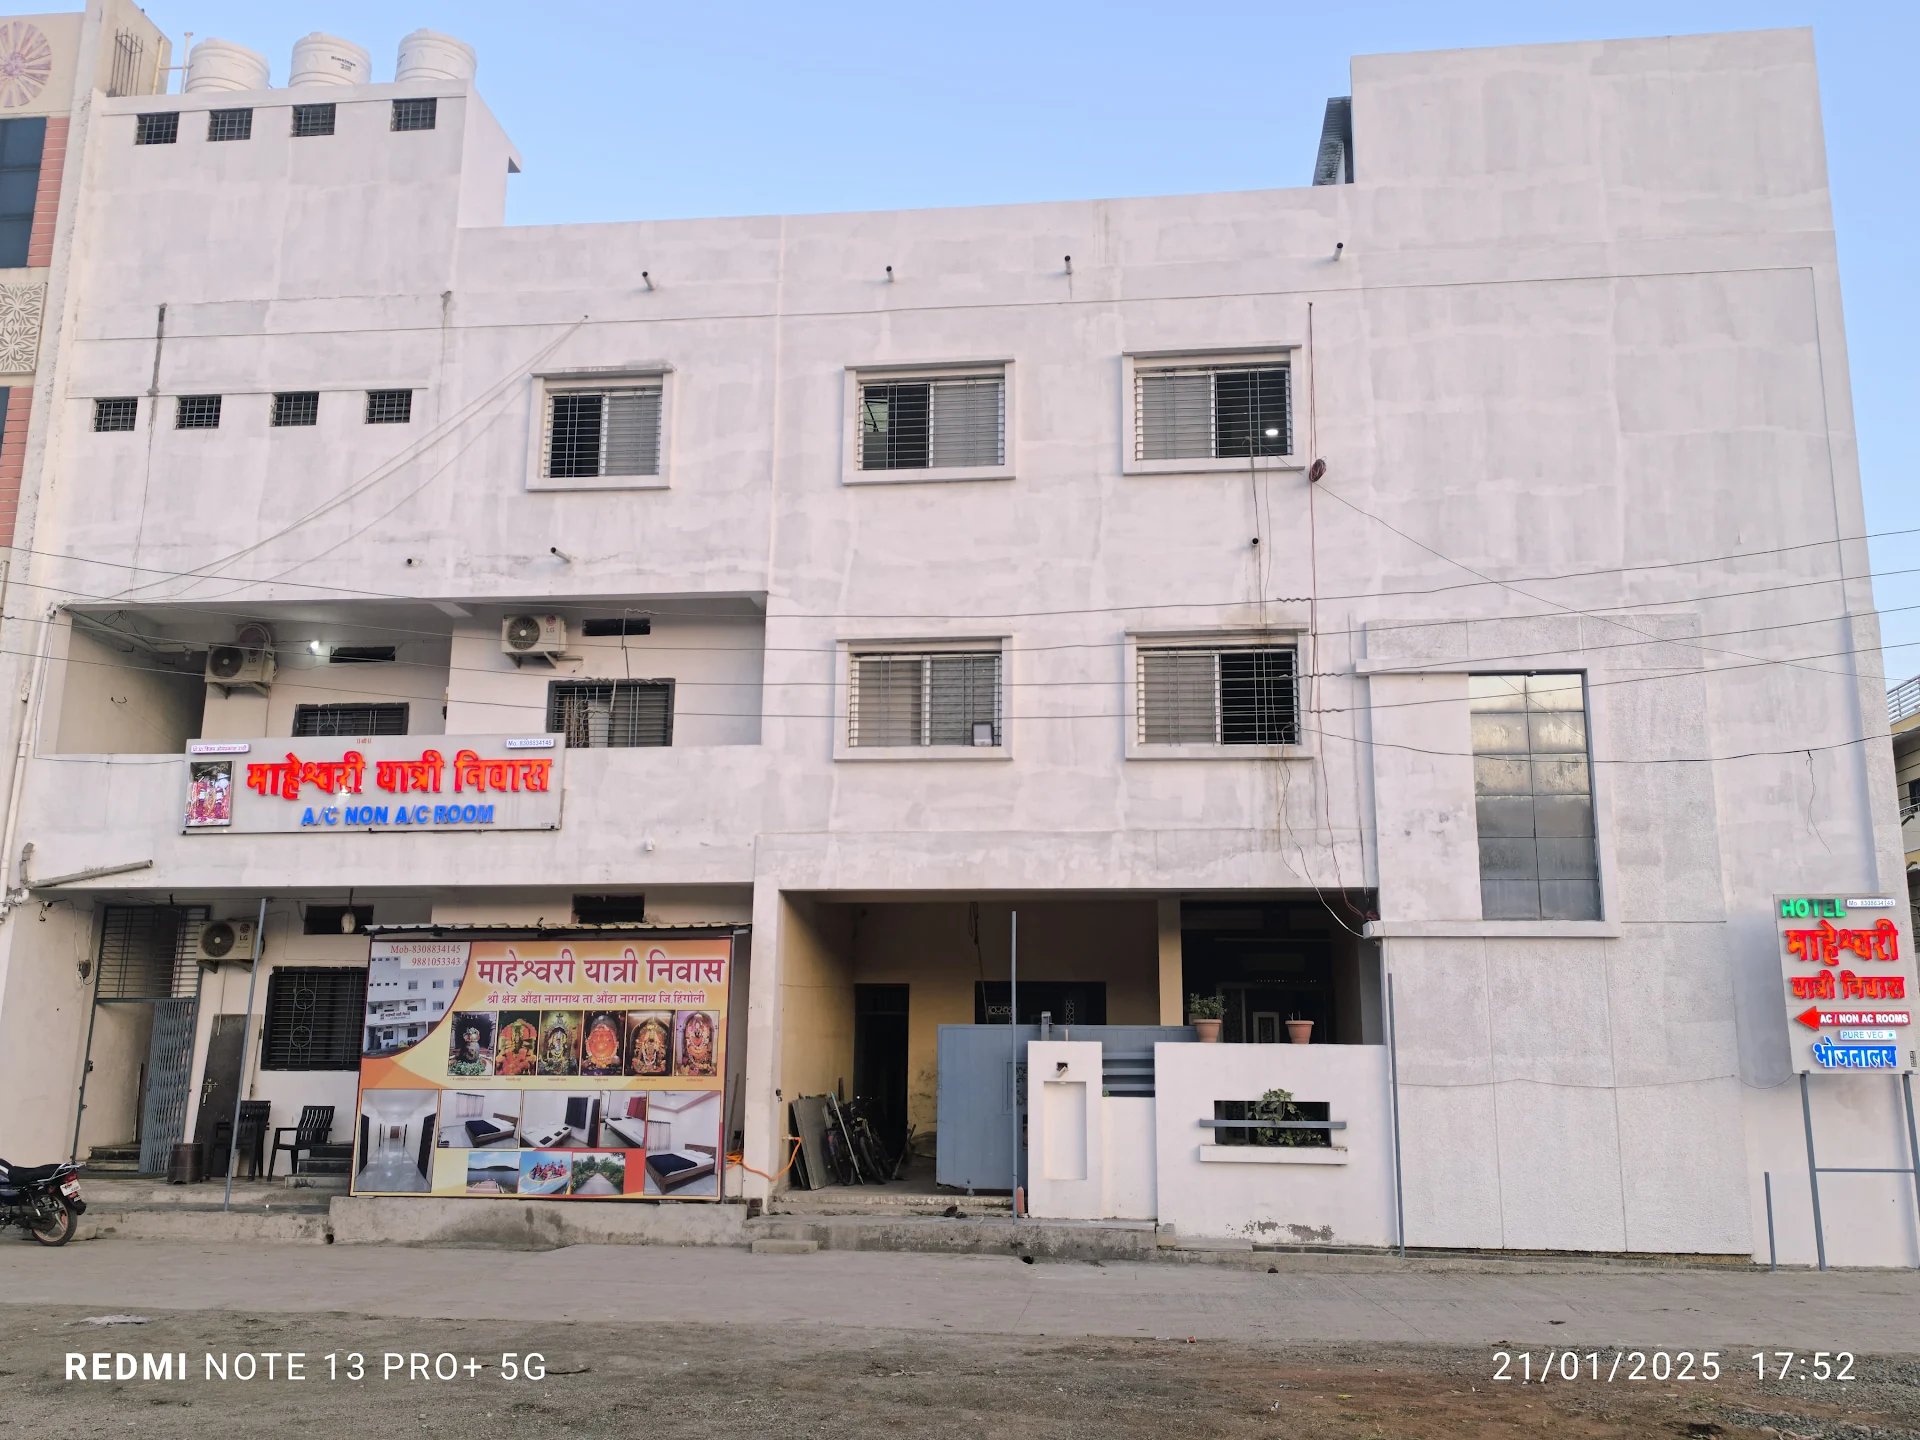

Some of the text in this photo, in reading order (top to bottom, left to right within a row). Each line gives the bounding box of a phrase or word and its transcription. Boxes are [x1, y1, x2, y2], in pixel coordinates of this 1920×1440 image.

[247, 749, 553, 800] माहेश्वरी यात्री निवास
[301, 804, 495, 826] A/C NON A/C ROOM
[1781, 898, 1847, 918] HOTEL
[390, 945, 461, 954] Mob-8308834145
[1785, 918, 1899, 966] माहेश्वरी
[411, 957, 461, 966] 9881053343
[477, 948, 726, 987] माहेश्वरी यात्री निवास
[1790, 969, 1905, 999] यात्री निवास
[487, 991, 499, 1004] श्री
[501, 992, 517, 1005] क्षेत्र
[520, 991, 541, 1004] औंढा
[544, 994, 580, 1004] नागनाथ
[620, 994, 656, 1004] नागनाथ
[1820, 1014, 1833, 1023] AC
[1839, 1014, 1859, 1023] NON
[1861, 1014, 1874, 1023] AC
[1876, 1014, 1909, 1023] ROOMS
[1842, 1031, 1884, 1039] PURE VEG
[1812, 1036, 1897, 1068] भोजनालय
